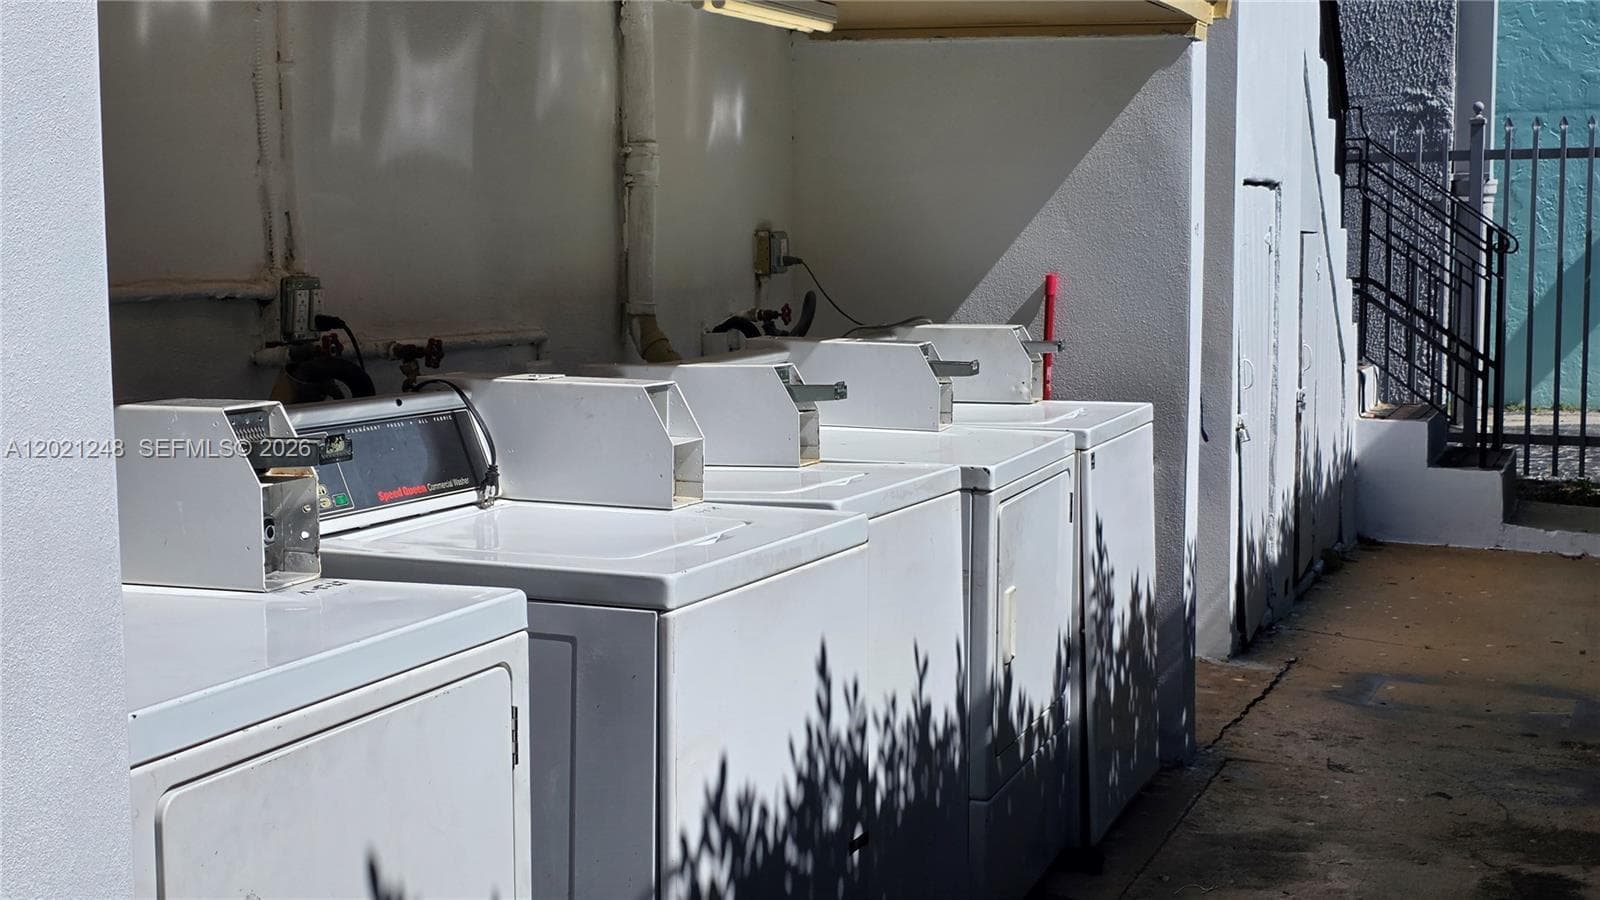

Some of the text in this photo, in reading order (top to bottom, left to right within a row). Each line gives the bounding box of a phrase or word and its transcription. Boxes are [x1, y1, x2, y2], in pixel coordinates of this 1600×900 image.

[377, 477, 470, 502] Speed Queen Commercial Washer
